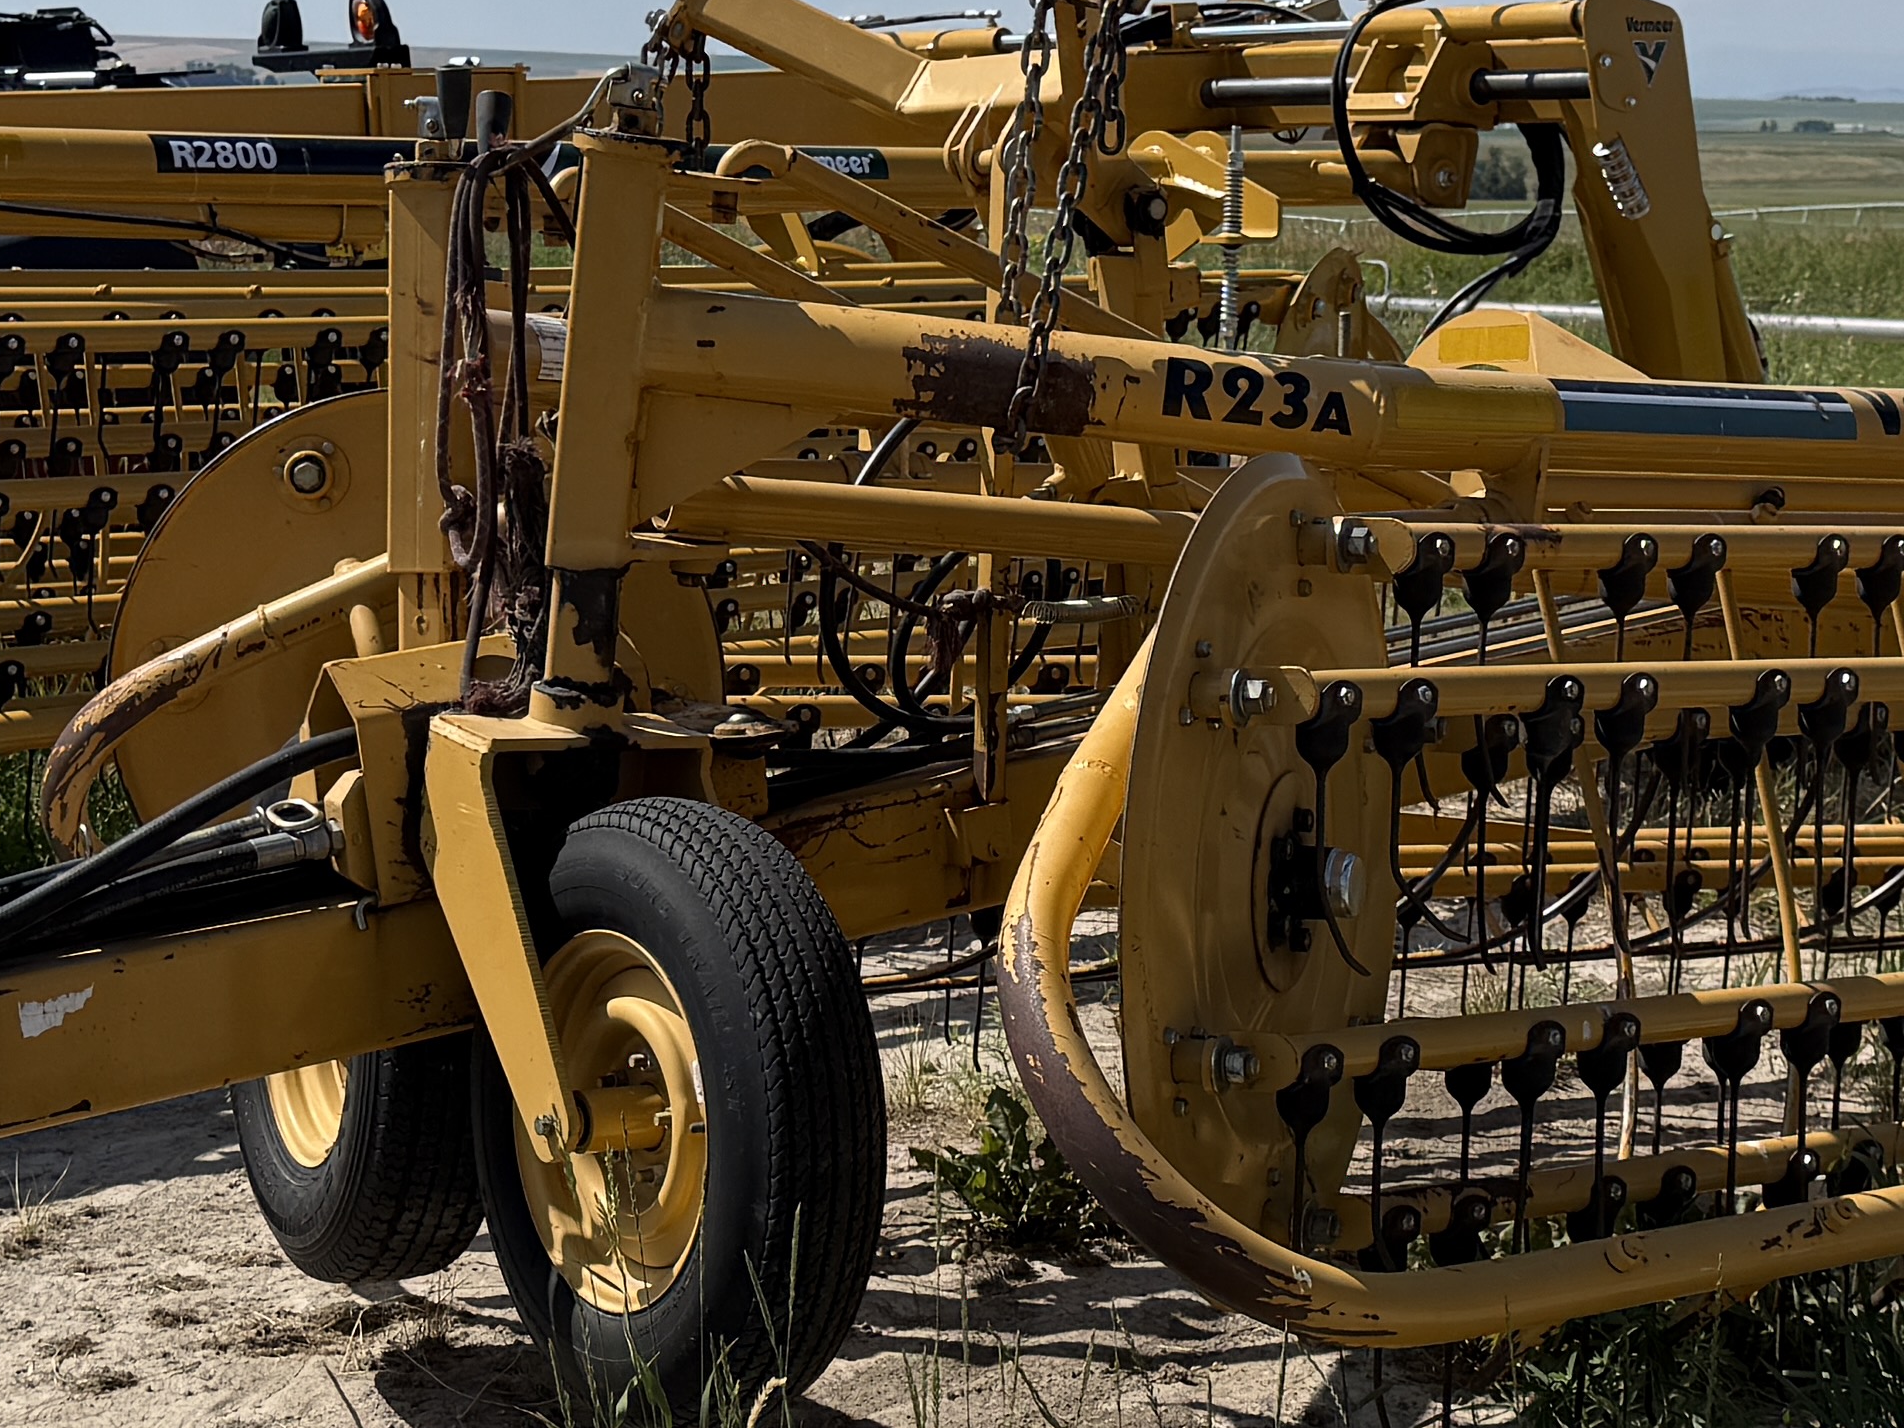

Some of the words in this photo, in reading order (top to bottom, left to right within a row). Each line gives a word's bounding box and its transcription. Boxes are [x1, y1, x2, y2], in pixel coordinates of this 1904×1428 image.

[168, 140, 278, 170] R2800
[812, 155, 871, 174] meer
[1161, 356, 1352, 436] R23A
